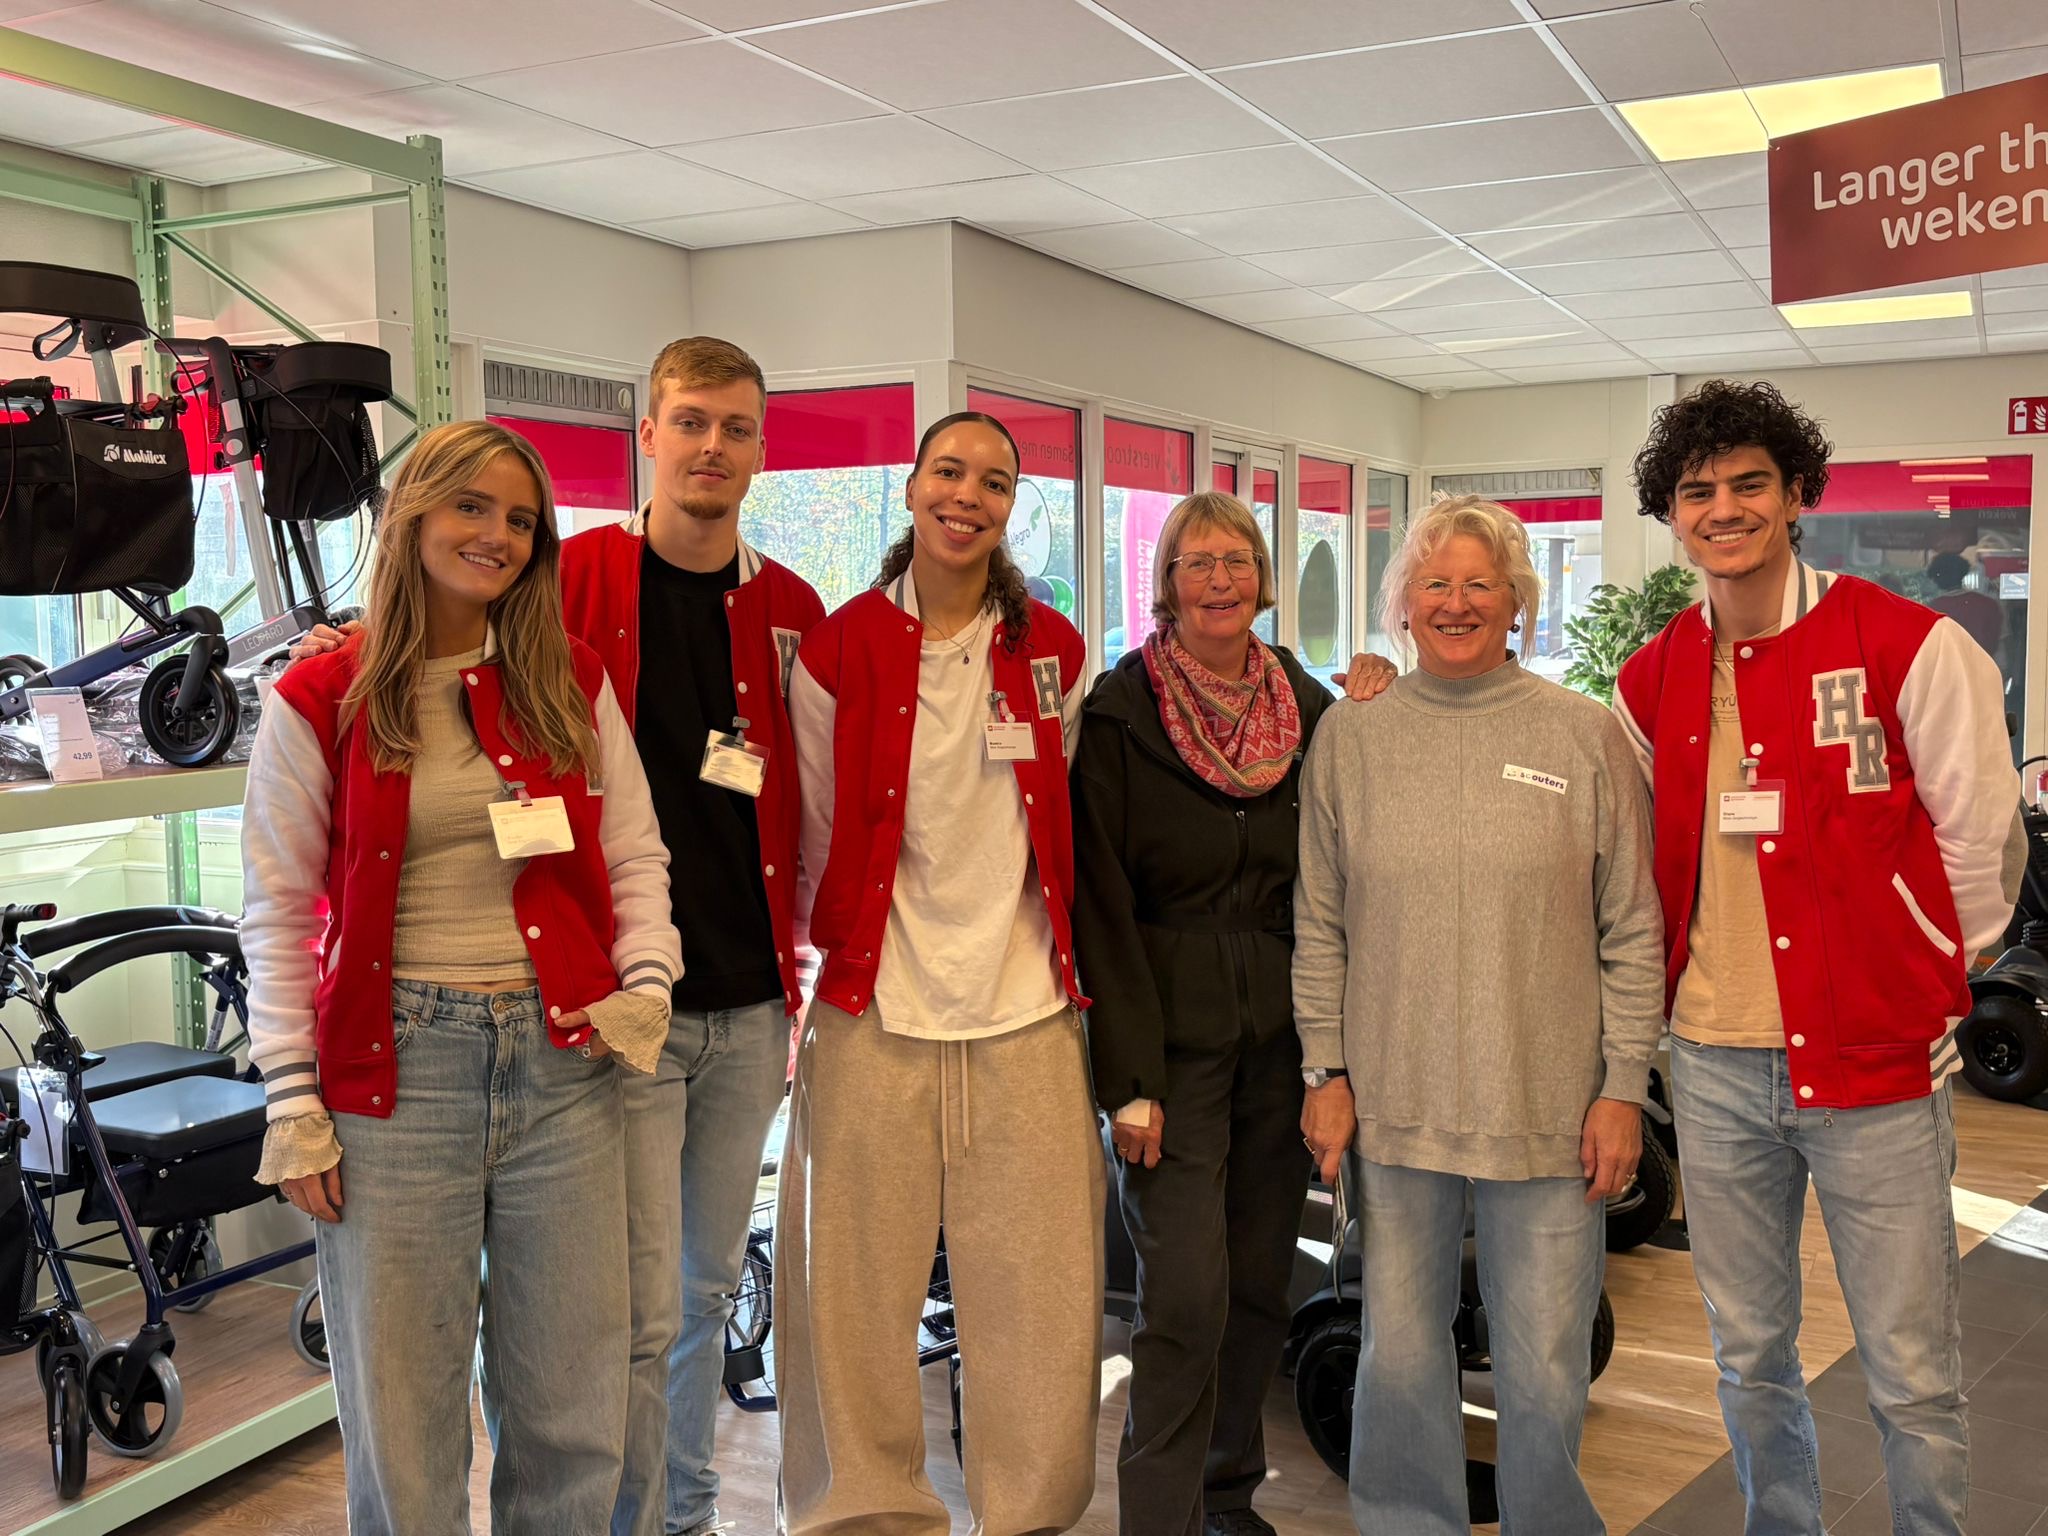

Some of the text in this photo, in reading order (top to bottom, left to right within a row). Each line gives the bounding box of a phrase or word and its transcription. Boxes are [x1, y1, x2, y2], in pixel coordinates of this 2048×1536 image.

[1813, 144, 1985, 211] Langer
[1881, 188, 2048, 249] weken
[242, 624, 284, 652] LEOPARD
